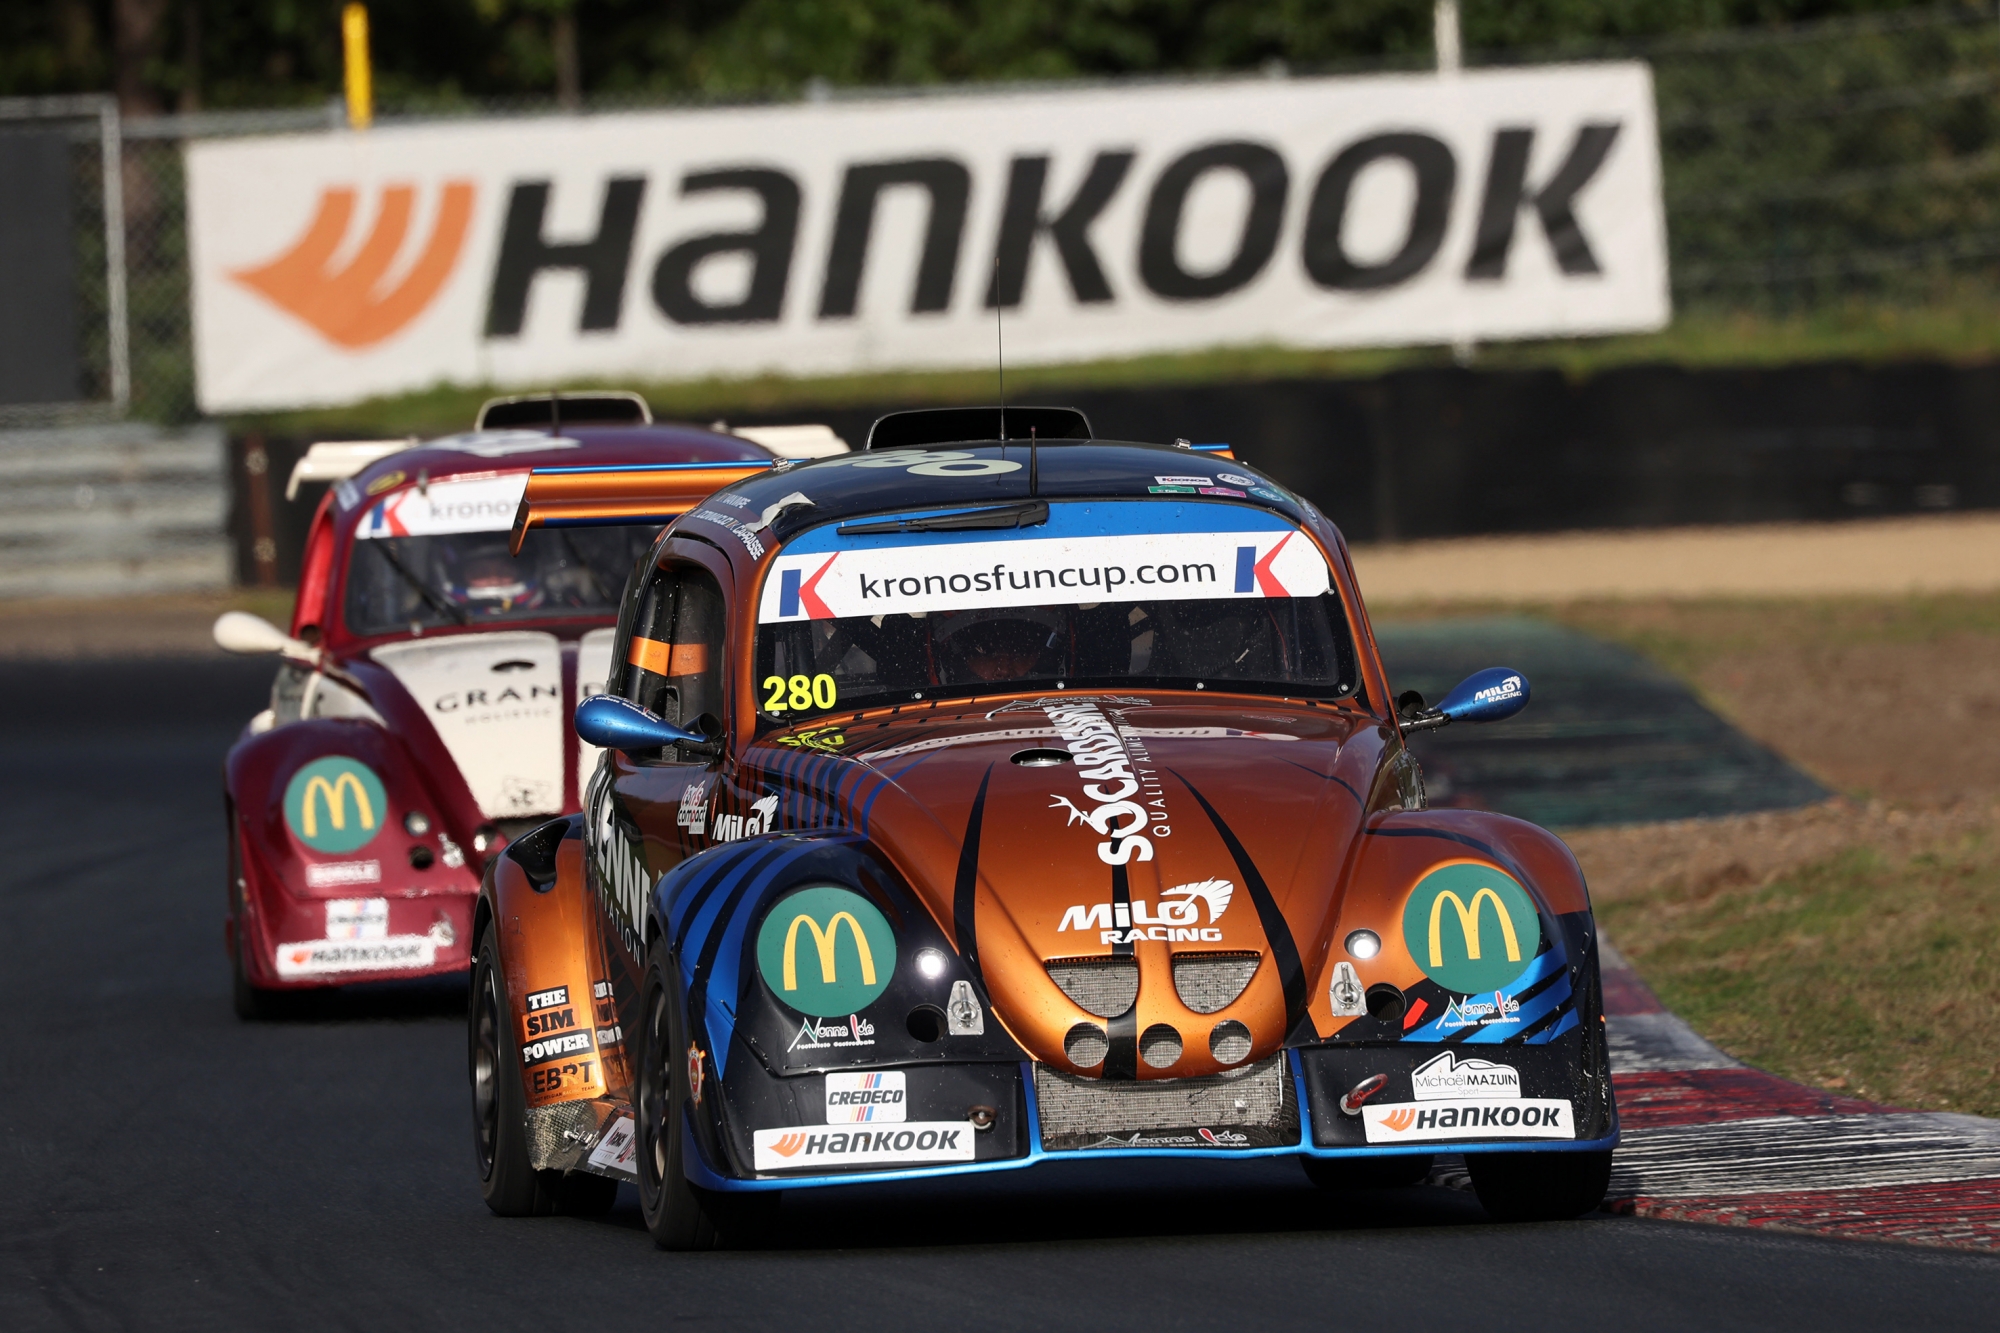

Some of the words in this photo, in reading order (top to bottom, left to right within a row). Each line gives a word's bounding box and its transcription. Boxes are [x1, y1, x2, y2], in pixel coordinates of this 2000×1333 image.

[860, 562, 1217, 599] kronosfuncup.com
[763, 673, 838, 712] 280
[1487, 690, 1522, 703] RACING
[1138, 767, 1172, 838] QUALITY
[1100, 926, 1222, 945] RACING
[528, 988, 567, 1010] THE
[1435, 994, 1495, 1030] Nonna
[526, 1008, 575, 1037] SIM
[787, 1016, 849, 1053] Nonna
[523, 1033, 590, 1063] POWER
[532, 1059, 597, 1095] EBRT
[1457, 1087, 1480, 1097] Sport
[828, 1089, 904, 1106] CREDECO
